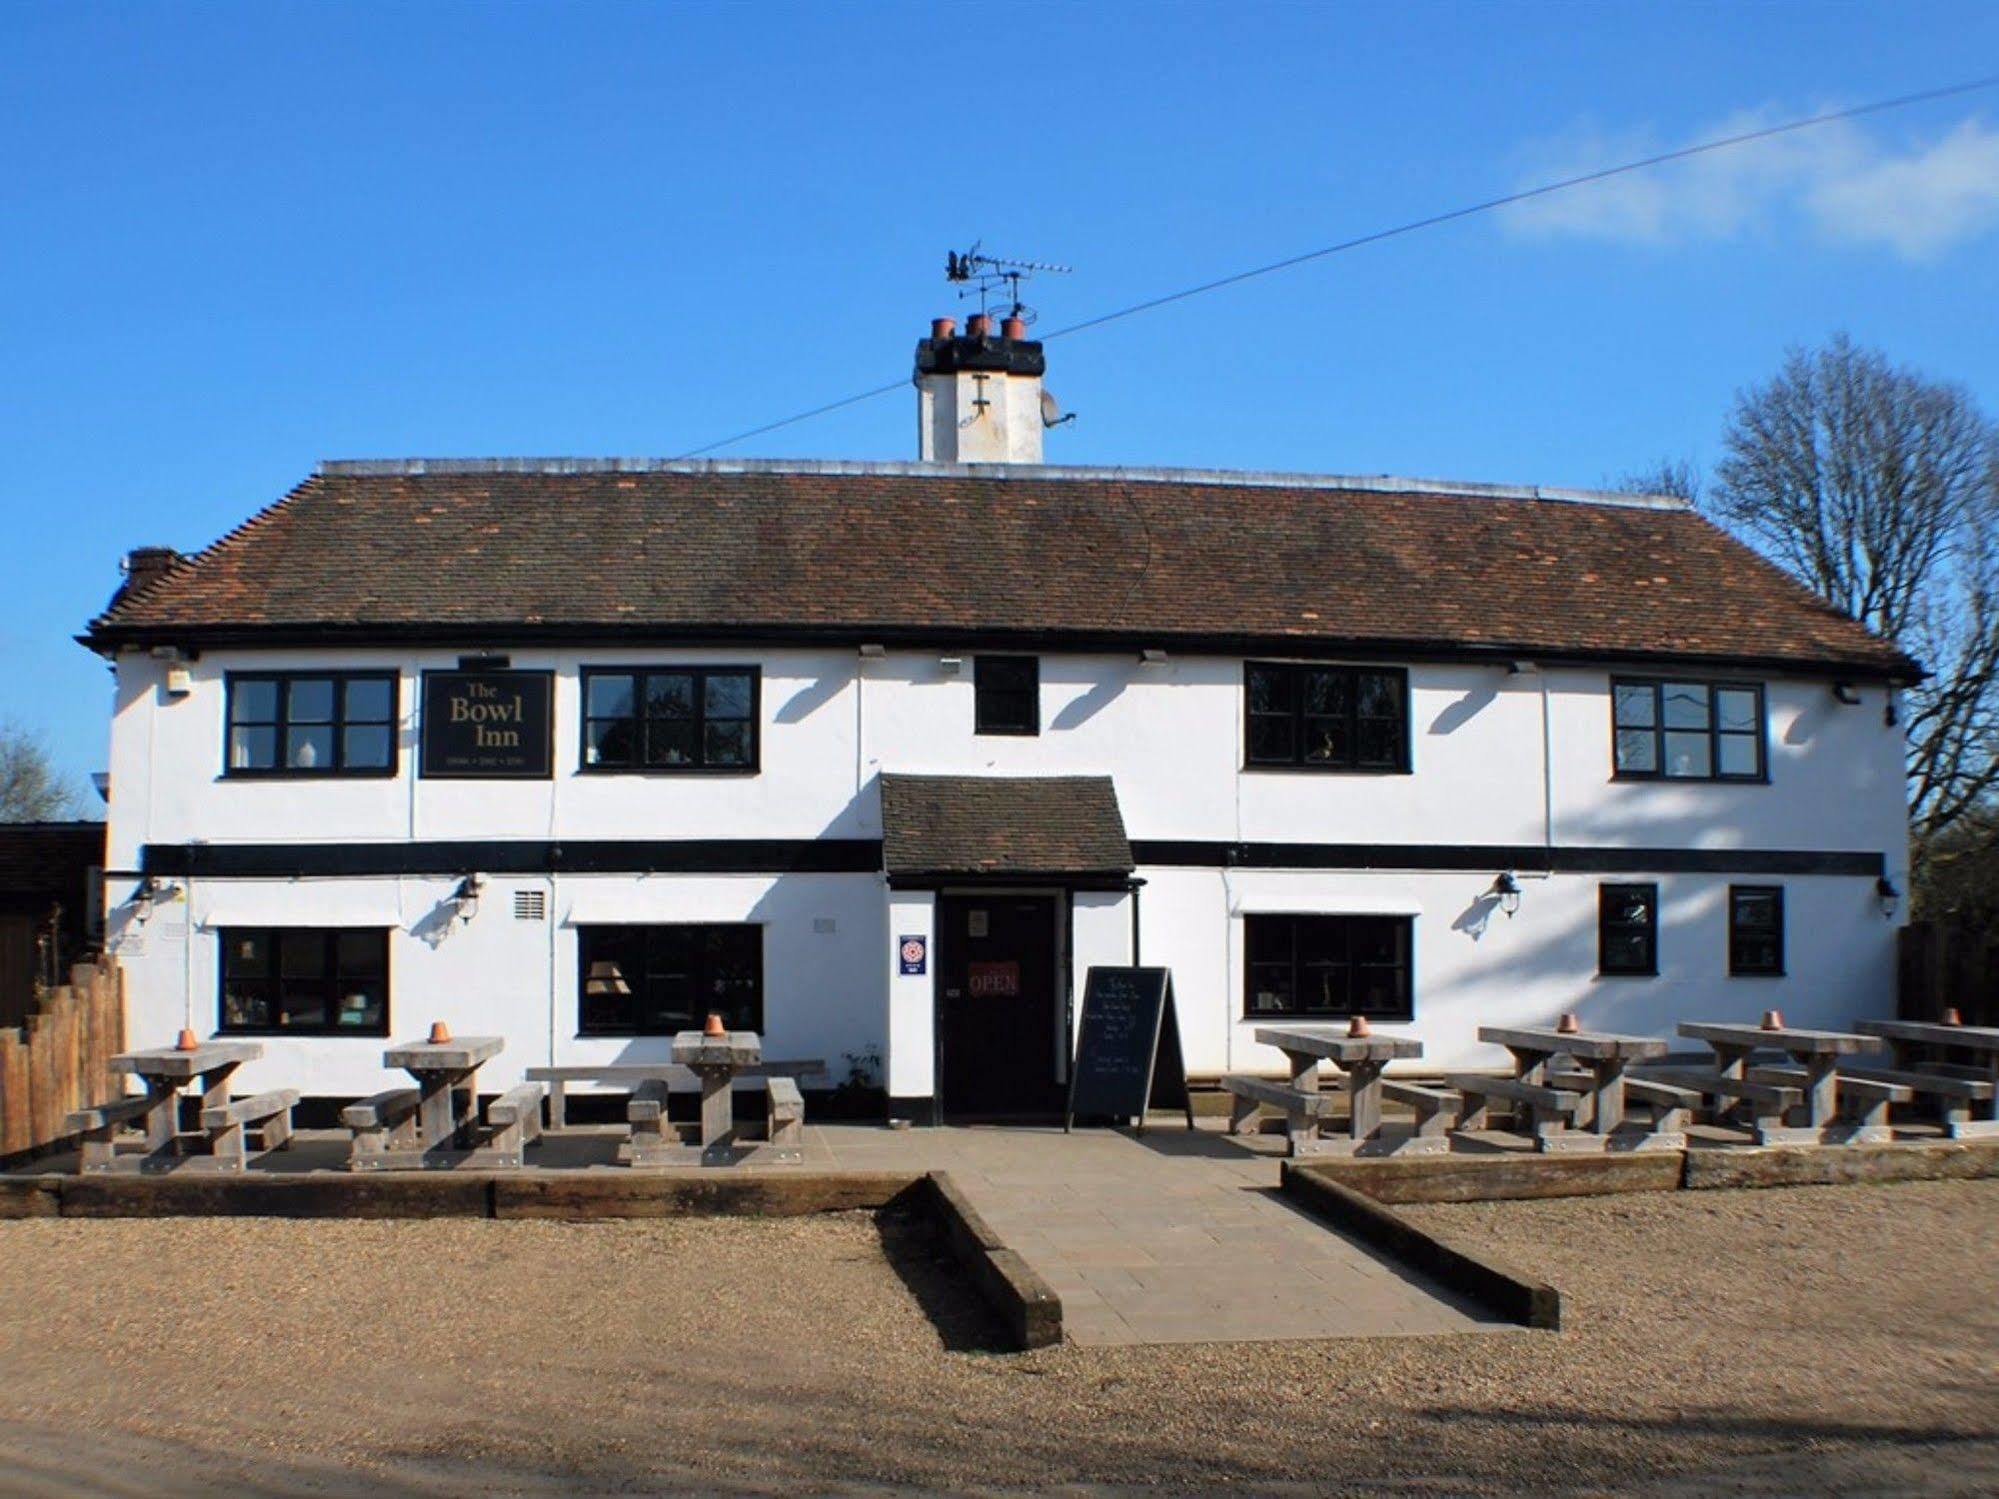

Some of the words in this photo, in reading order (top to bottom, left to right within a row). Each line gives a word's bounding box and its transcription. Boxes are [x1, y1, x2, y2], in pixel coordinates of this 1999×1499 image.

[467, 682, 498, 698] The
[450, 696, 523, 722] Bowl
[477, 725, 519, 747] Inn
[969, 975, 1016, 992] OPEN
